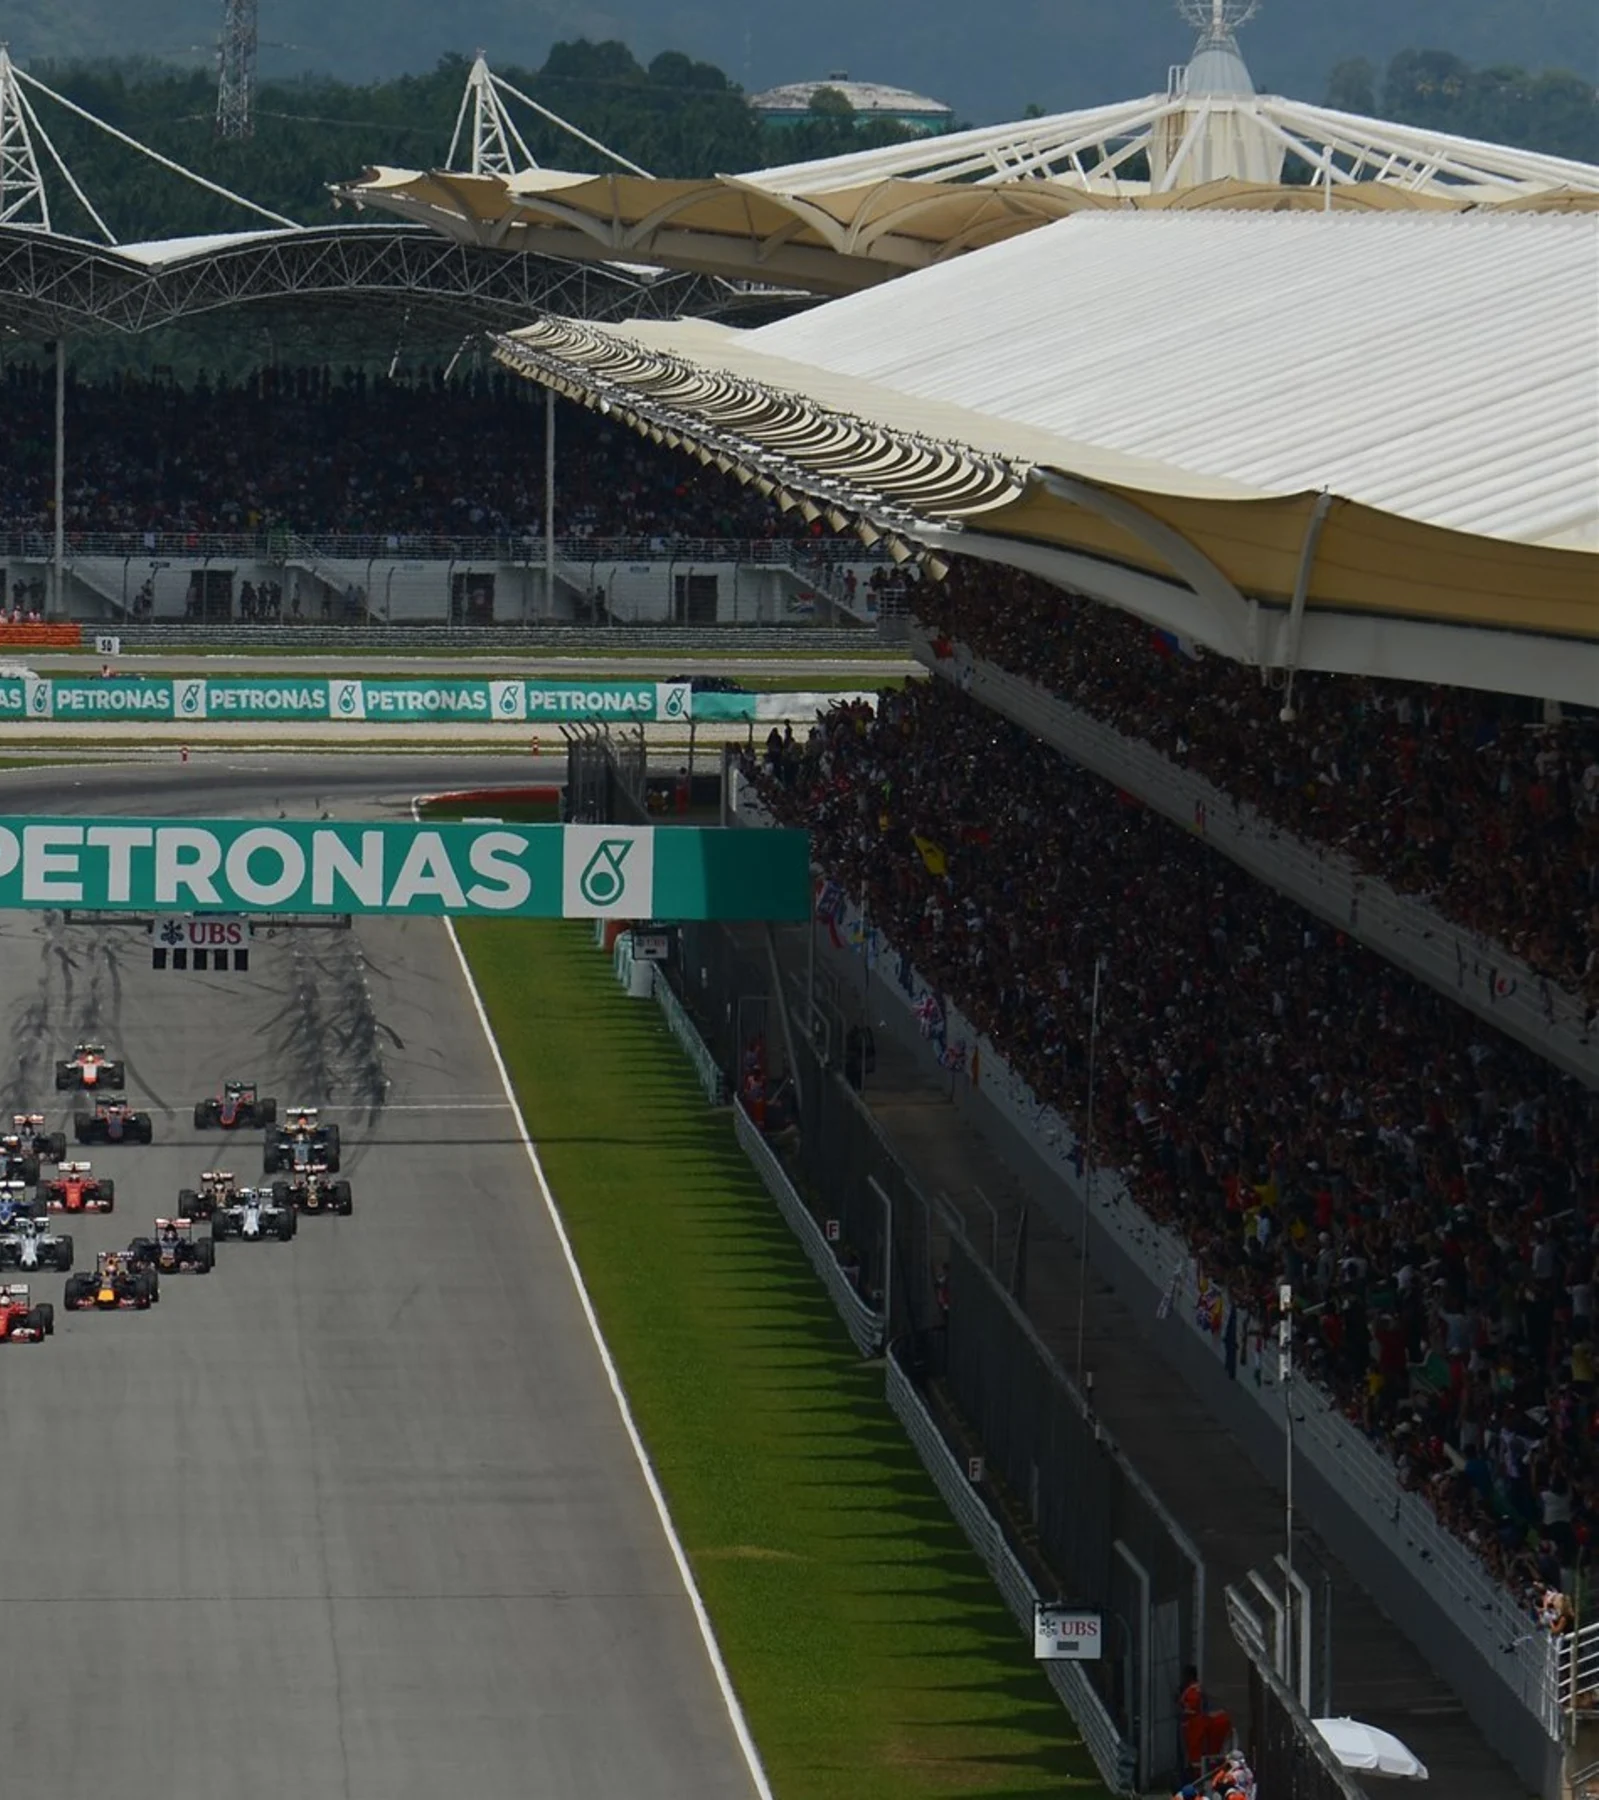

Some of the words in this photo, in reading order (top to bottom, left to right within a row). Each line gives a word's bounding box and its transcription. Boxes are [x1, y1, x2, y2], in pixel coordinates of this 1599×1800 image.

[57, 689, 170, 709] PETRONAS
[210, 688, 326, 710] PETRONAS
[367, 690, 487, 711] PETRONAS
[530, 690, 652, 712] PETRONAS
[188, 922, 242, 944] UBS
[1061, 1620, 1098, 1637] UBS
